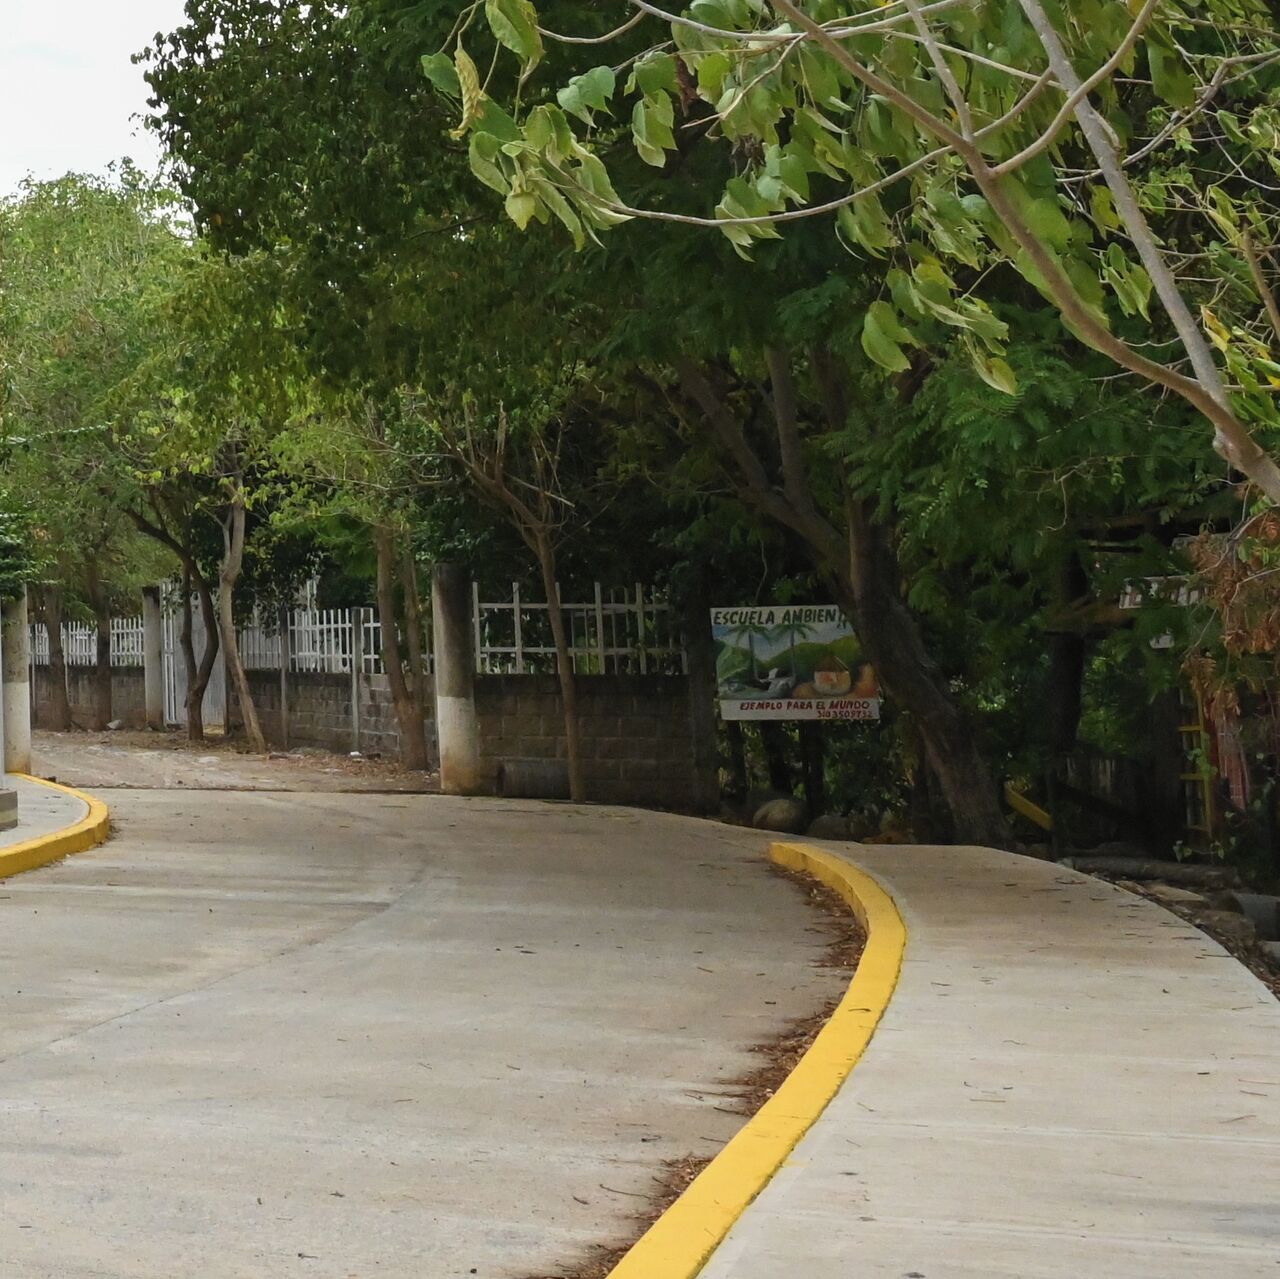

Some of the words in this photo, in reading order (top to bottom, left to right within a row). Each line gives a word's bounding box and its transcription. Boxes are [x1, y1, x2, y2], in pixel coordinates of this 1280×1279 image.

[713, 610, 775, 625] ESCUELA
[739, 701, 783, 711] EJEMPLO
[786, 701, 813, 710] PARA
[829, 700, 870, 710] MUNDO
